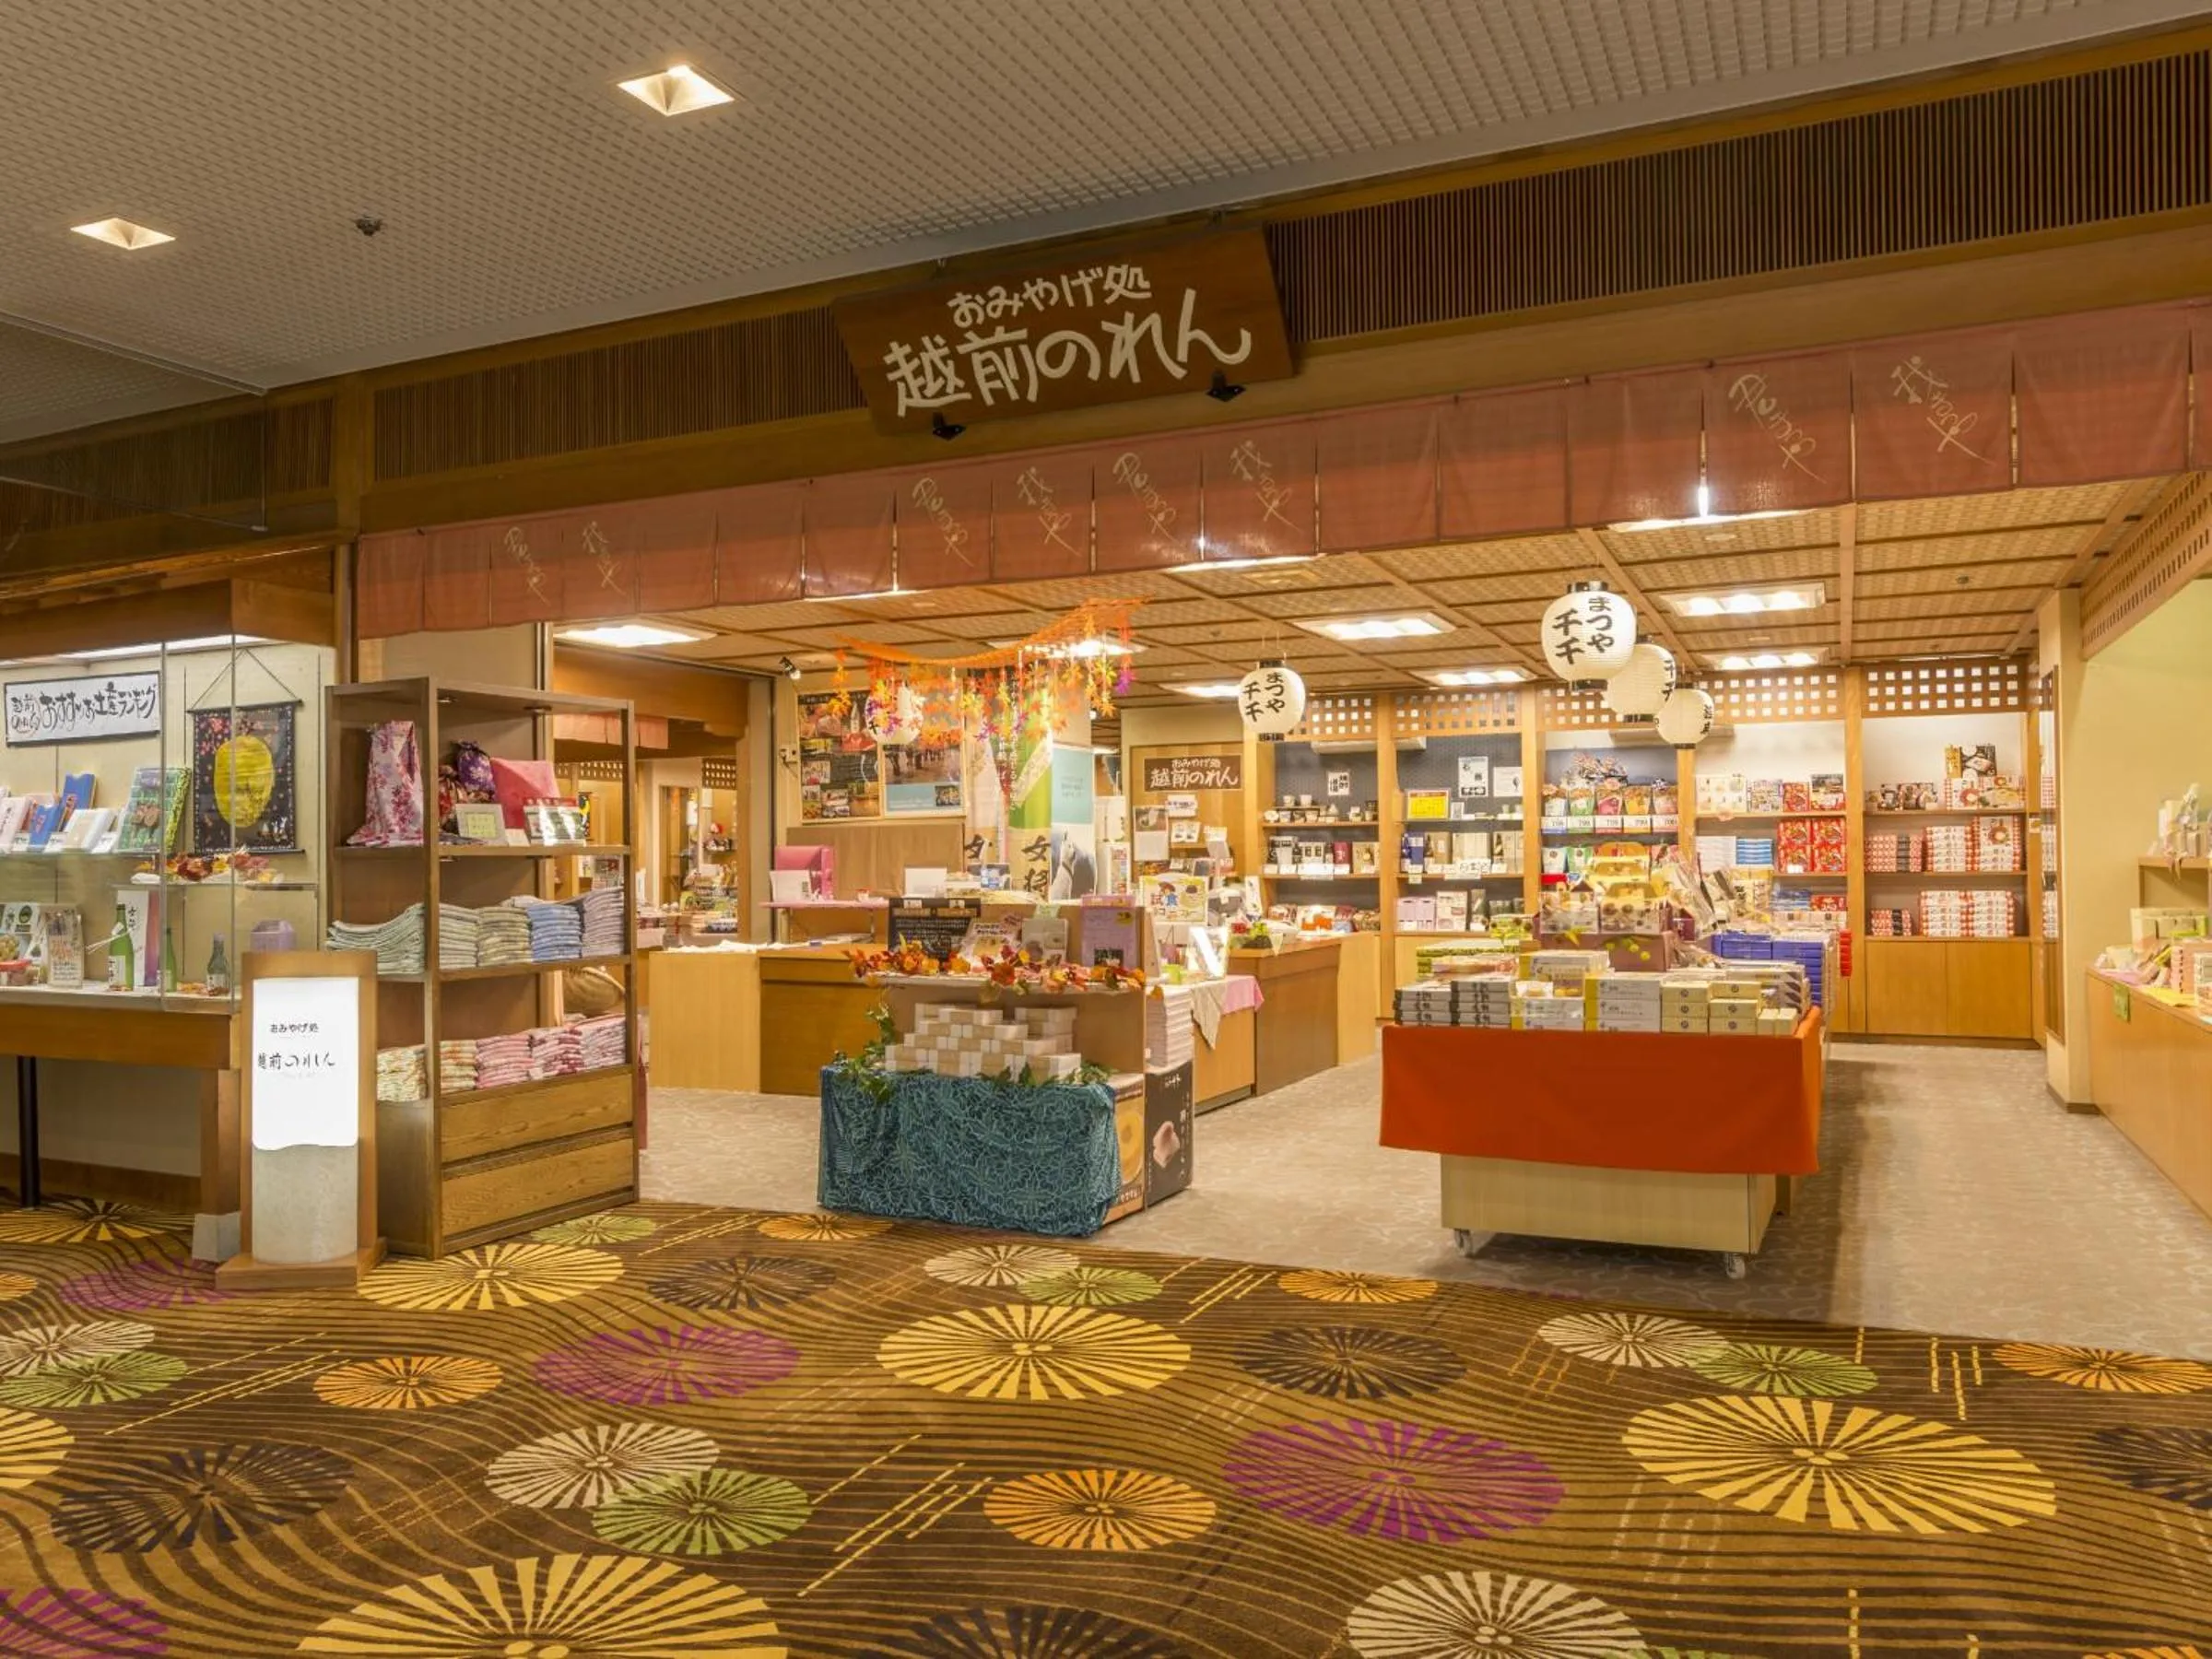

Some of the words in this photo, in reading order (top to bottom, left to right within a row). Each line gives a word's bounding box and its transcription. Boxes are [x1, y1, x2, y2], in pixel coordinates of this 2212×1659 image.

[947, 264, 1152, 328] おみやげ処
[882, 288, 1252, 418] 越前のれん
[1552, 608, 1585, 665] 千千
[1586, 596, 1613, 653] まつや
[1243, 681, 1264, 722] 千千
[1265, 672, 1285, 712] まつや
[1150, 767, 1239, 788] 越前のれん
